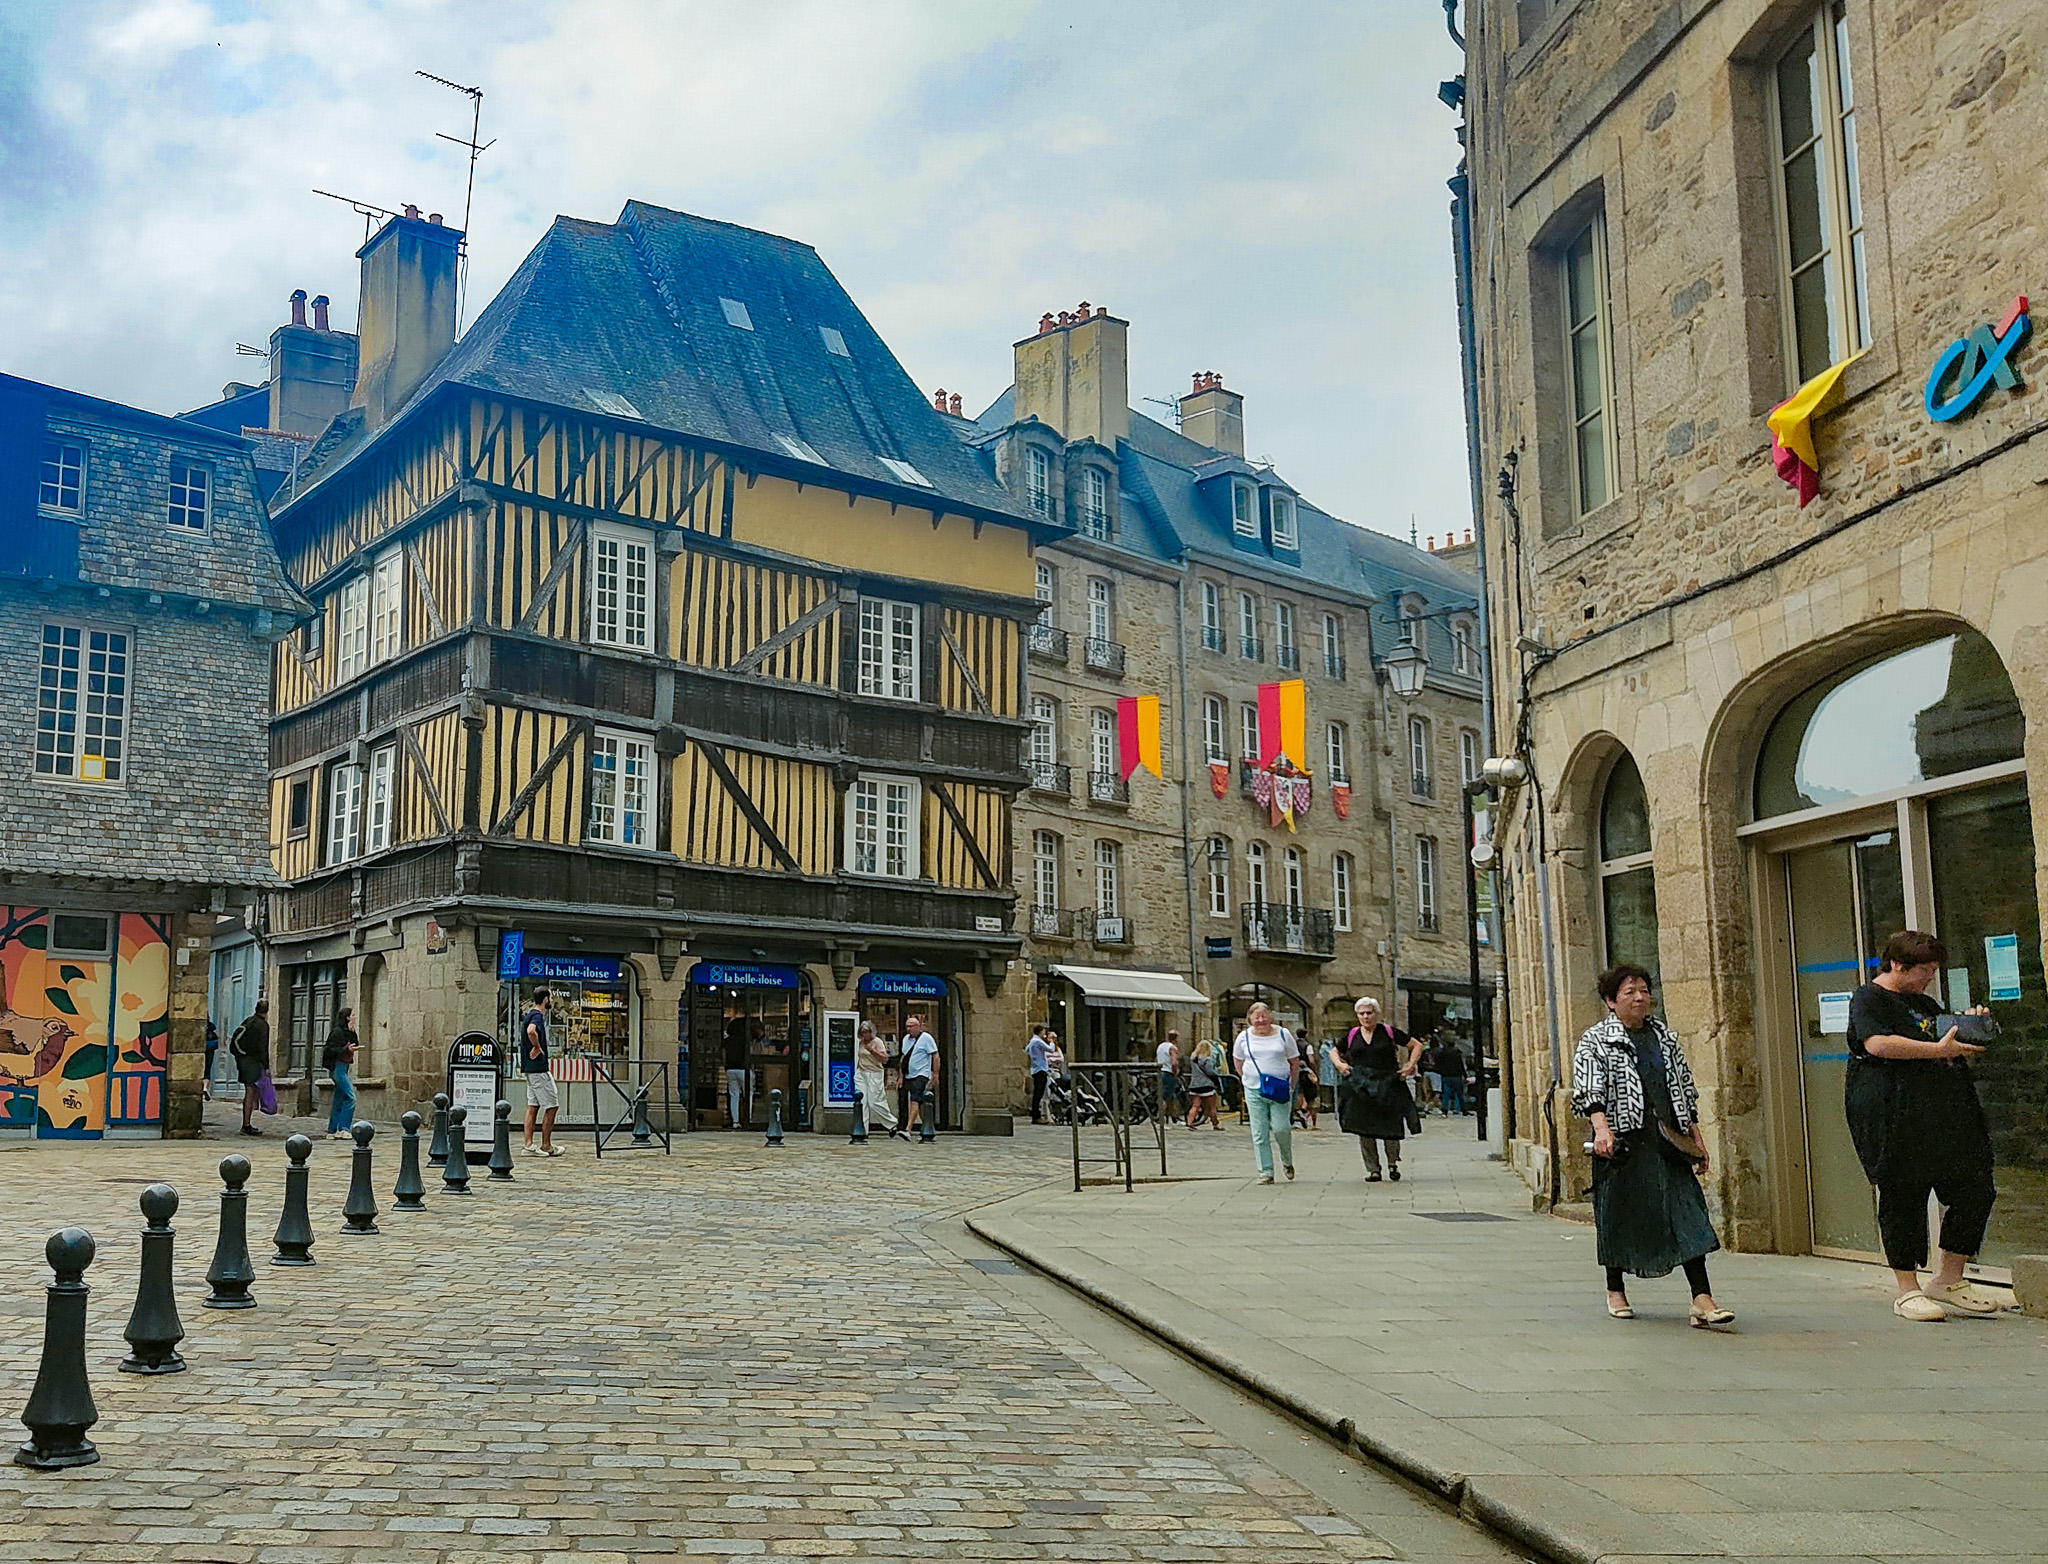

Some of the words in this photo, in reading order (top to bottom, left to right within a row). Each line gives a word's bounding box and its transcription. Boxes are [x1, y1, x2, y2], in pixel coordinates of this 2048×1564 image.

[545, 956, 585, 965] CONSERVERIE
[545, 964, 554, 976] la
[556, 965, 610, 979] belle-iloise
[724, 965, 760, 973] CONSERVERIE
[724, 972, 732, 983] la
[734, 973, 783, 985] belle-iloise
[552, 988, 571, 997] vivre
[884, 981, 892, 992] la
[893, 981, 937, 995] belle-iloise
[459, 1043, 493, 1057] MIMOSA
